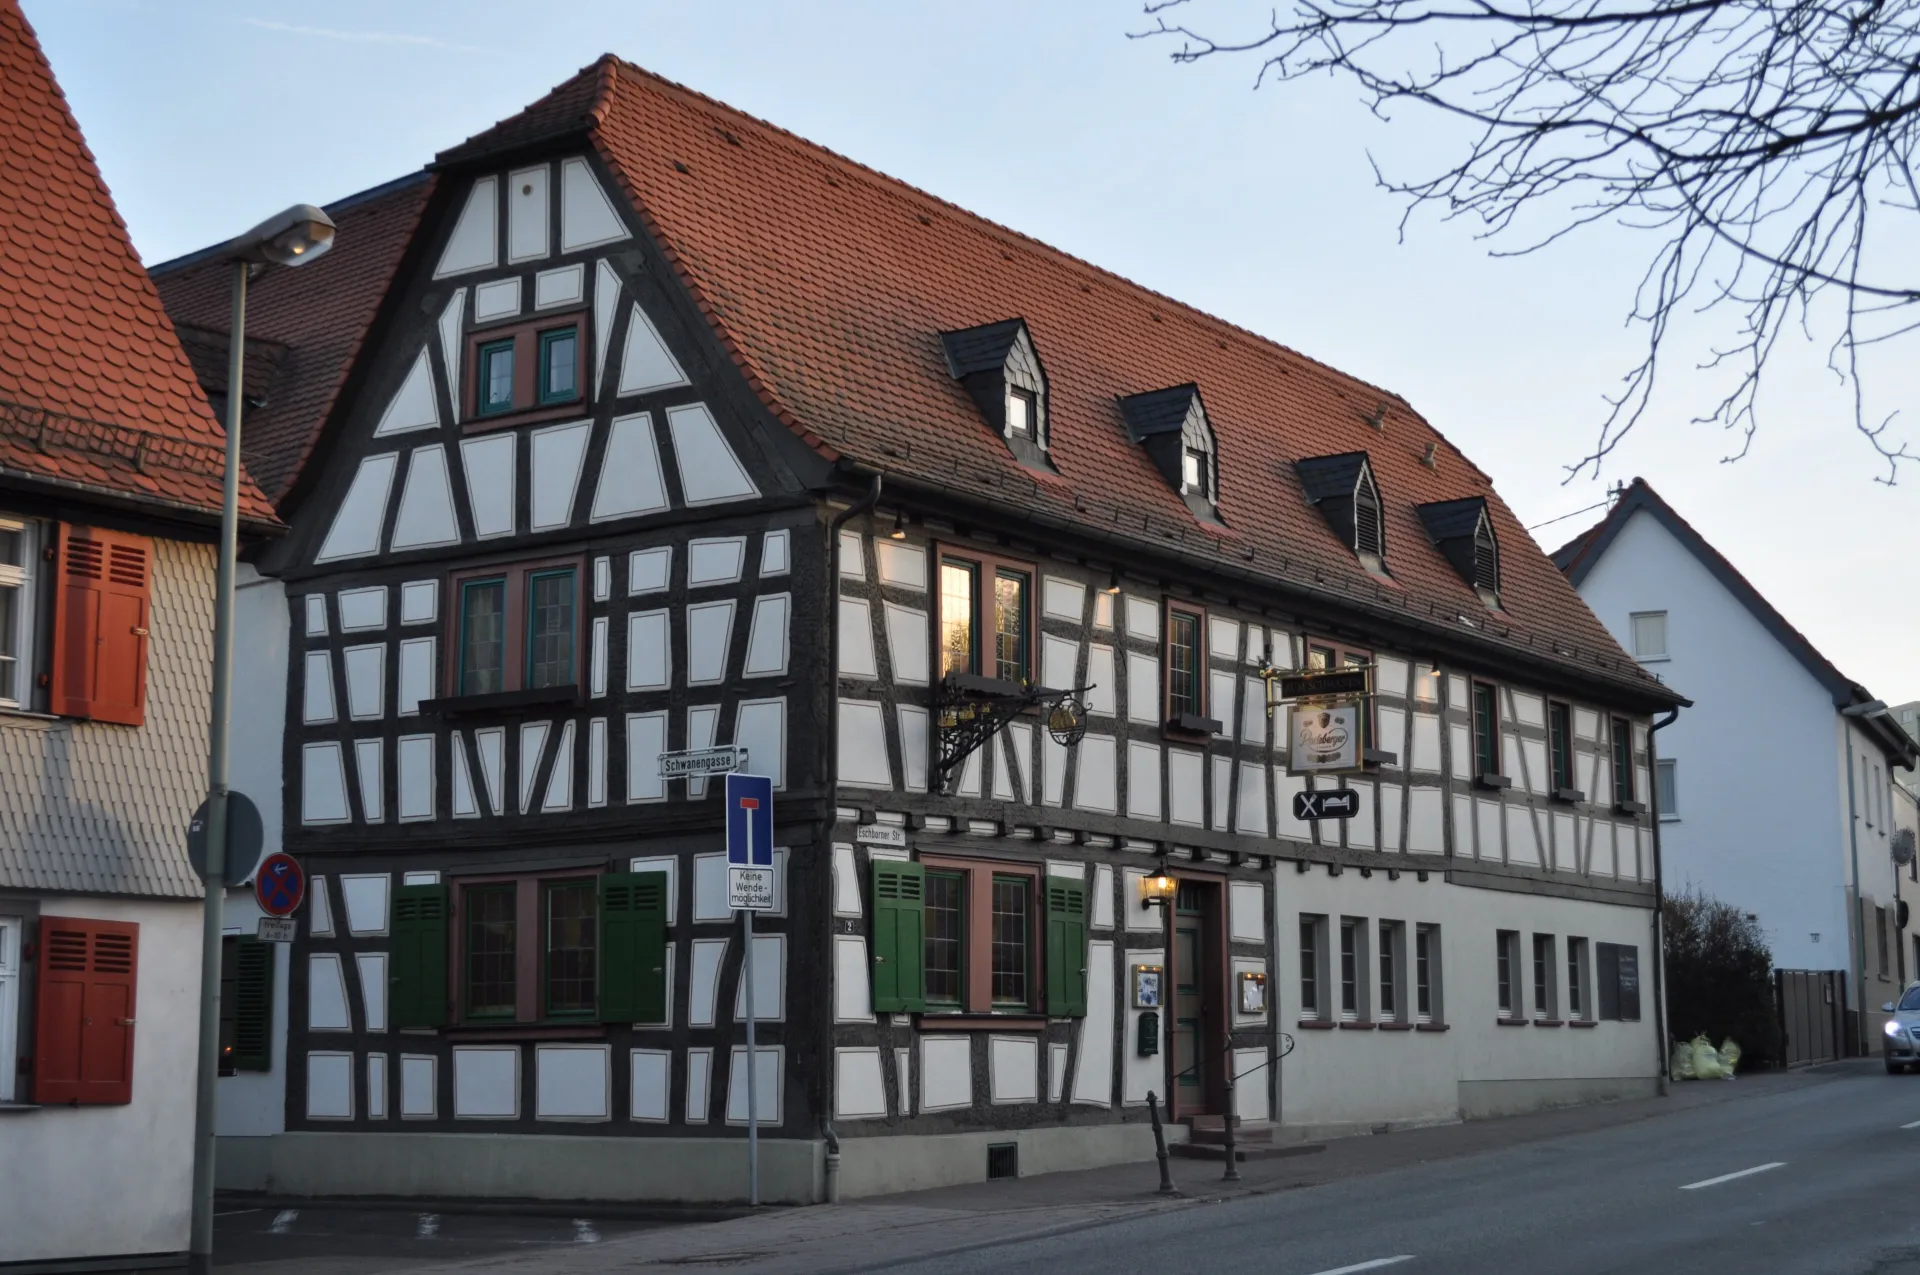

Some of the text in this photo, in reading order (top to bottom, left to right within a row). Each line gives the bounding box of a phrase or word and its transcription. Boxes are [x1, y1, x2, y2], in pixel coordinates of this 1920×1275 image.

[665, 755, 731, 772] Schwanengasse
[859, 827, 890, 840] Eschborner
[740, 870, 762, 881] Keine
